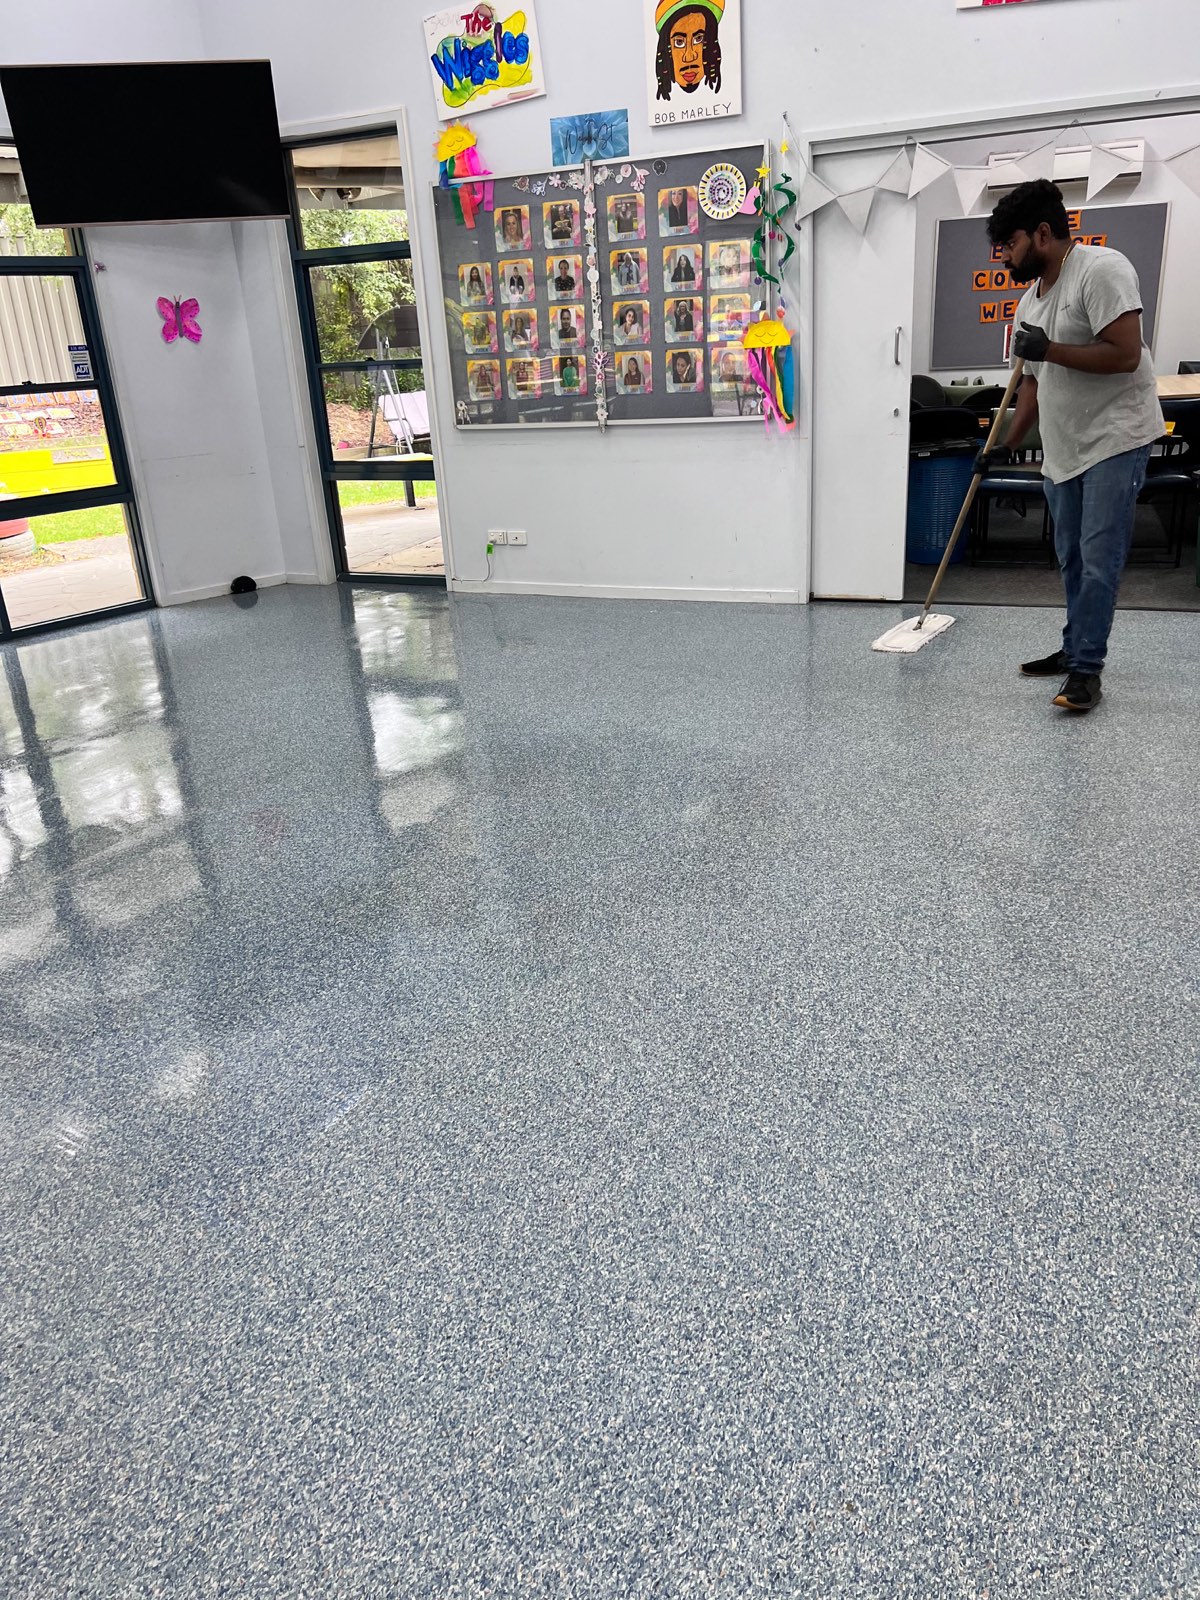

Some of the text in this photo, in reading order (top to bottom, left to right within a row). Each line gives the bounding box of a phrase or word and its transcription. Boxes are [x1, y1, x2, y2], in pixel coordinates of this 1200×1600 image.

[461, 10, 494, 34] The
[654, 102, 732, 124] BOB MARLEY
